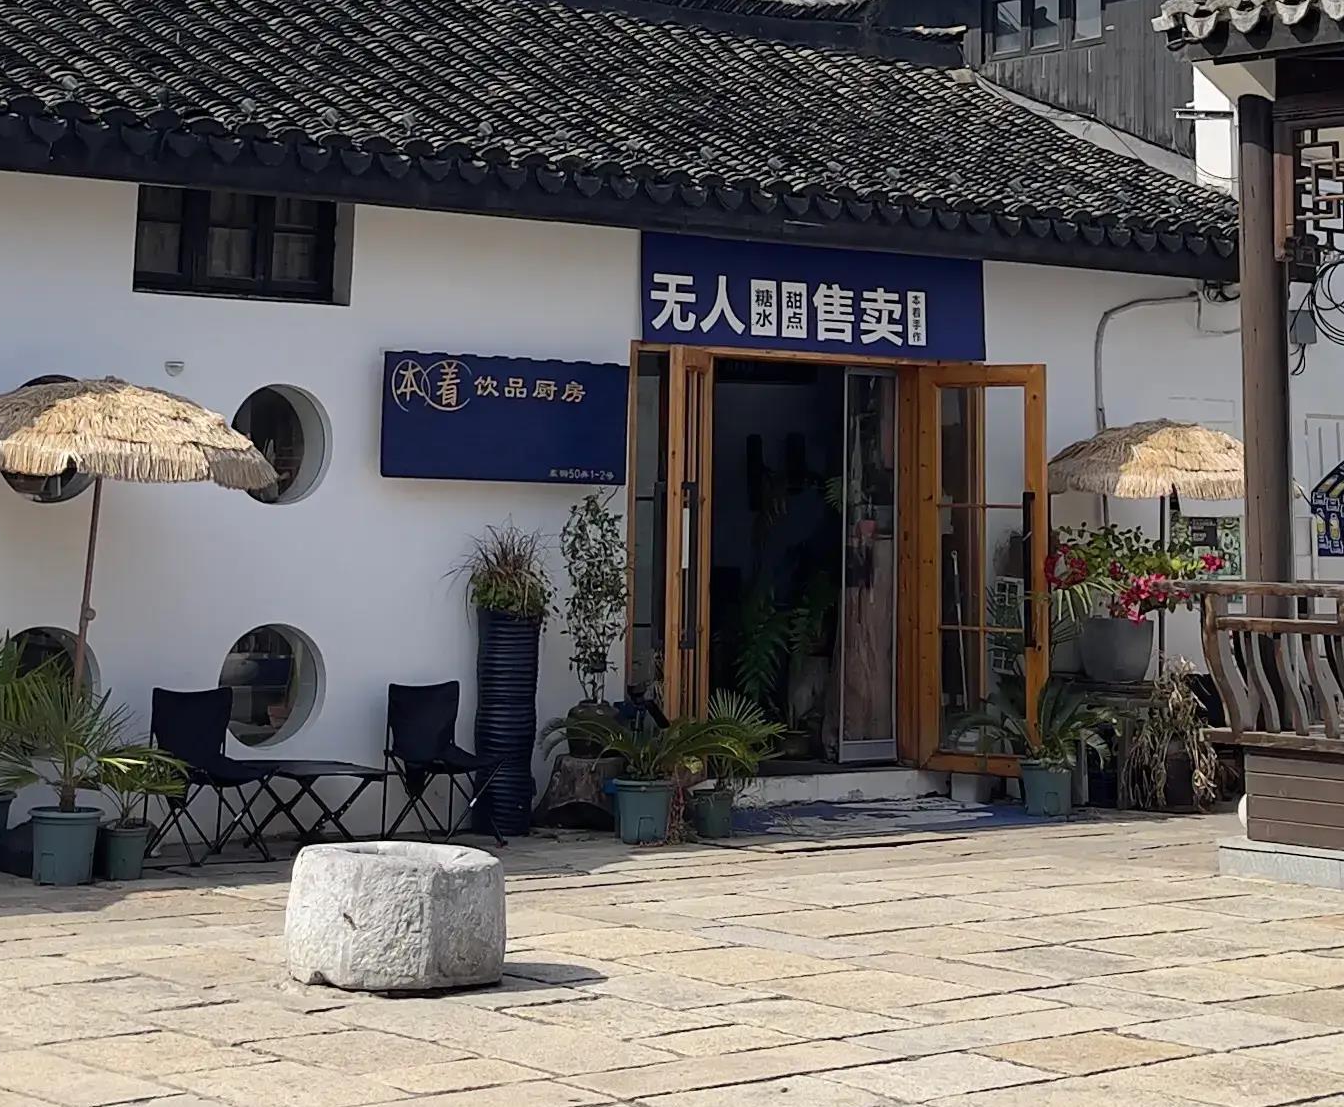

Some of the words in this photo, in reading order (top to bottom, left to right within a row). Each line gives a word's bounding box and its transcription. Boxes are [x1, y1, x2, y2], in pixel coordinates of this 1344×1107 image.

[650, 272, 746, 335] 无人
[754, 288, 773, 328] 糖水
[786, 290, 804, 330] 甜点
[812, 283, 904, 346] 售卖
[910, 294, 922, 343] 本着手作
[396, 359, 461, 407] 本着
[474, 375, 586, 403] 饮品厨房
